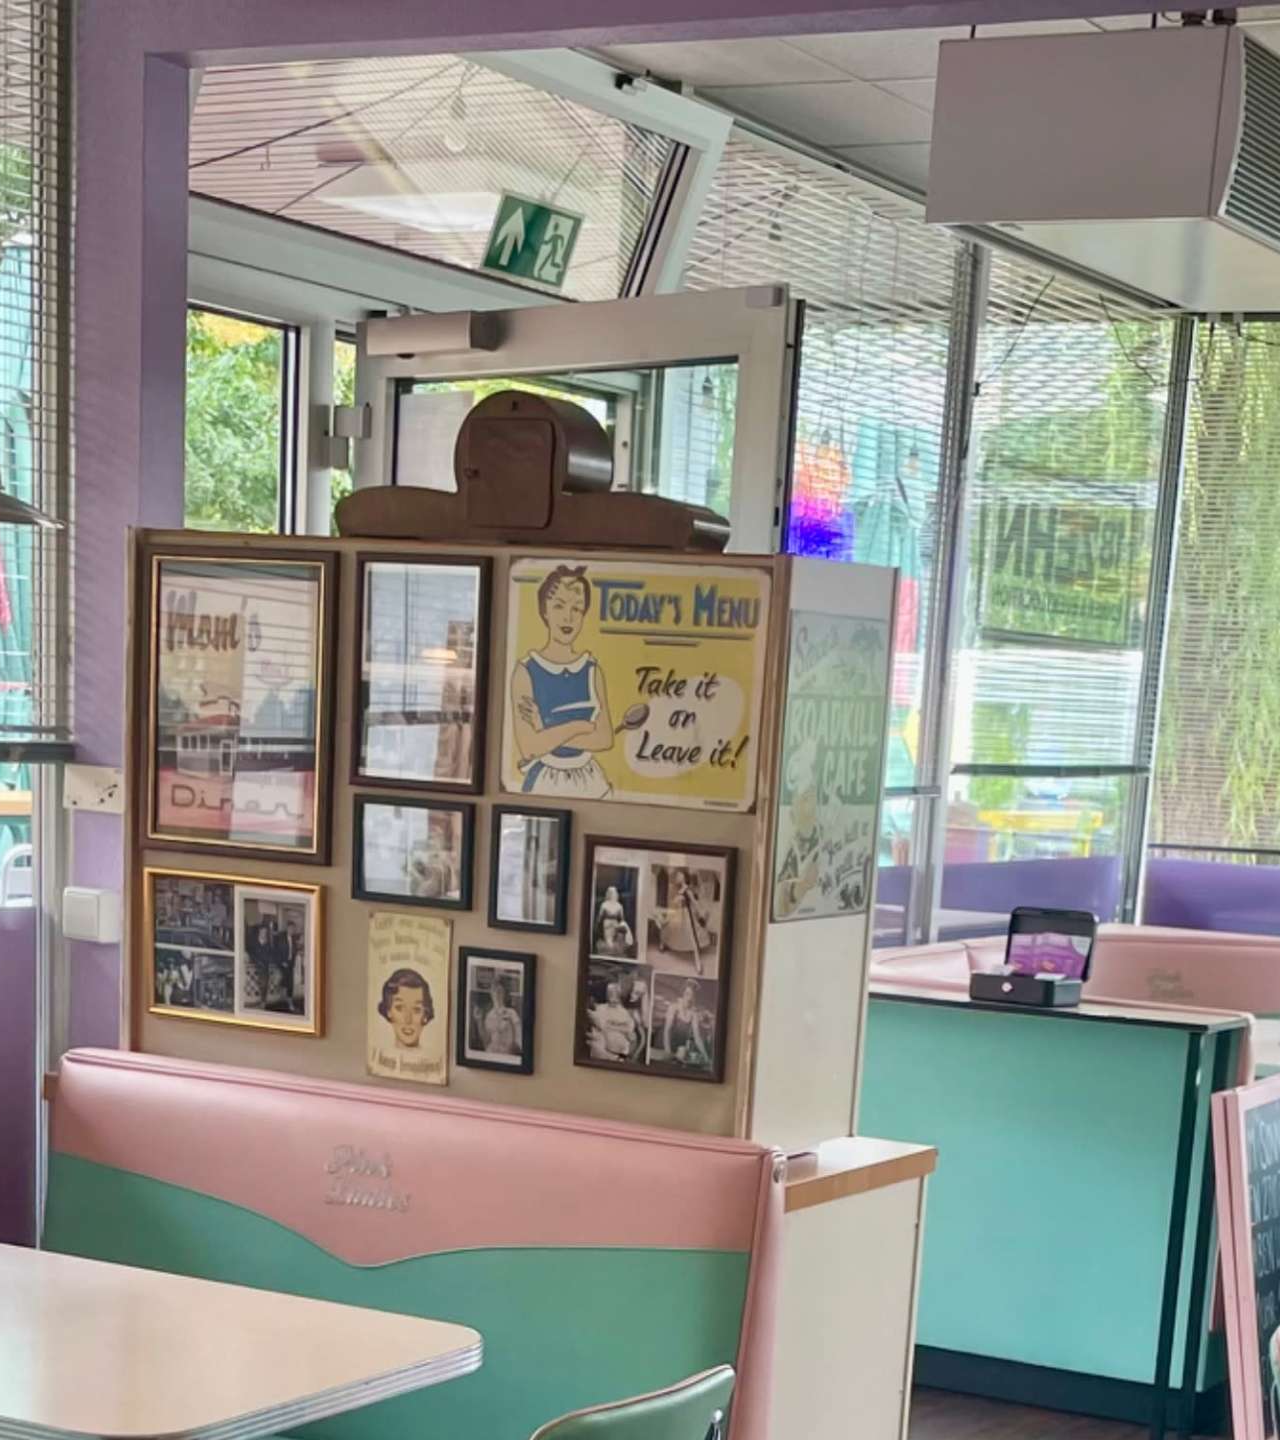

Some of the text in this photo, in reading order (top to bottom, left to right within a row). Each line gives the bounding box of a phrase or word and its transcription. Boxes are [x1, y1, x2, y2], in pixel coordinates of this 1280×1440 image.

[592, 578, 761, 629] TODAY'S MENU
[635, 665, 720, 700] Take it
[668, 709, 697, 728] or
[636, 730, 749, 769] Leave it!
[170, 784, 304, 818] Diner
